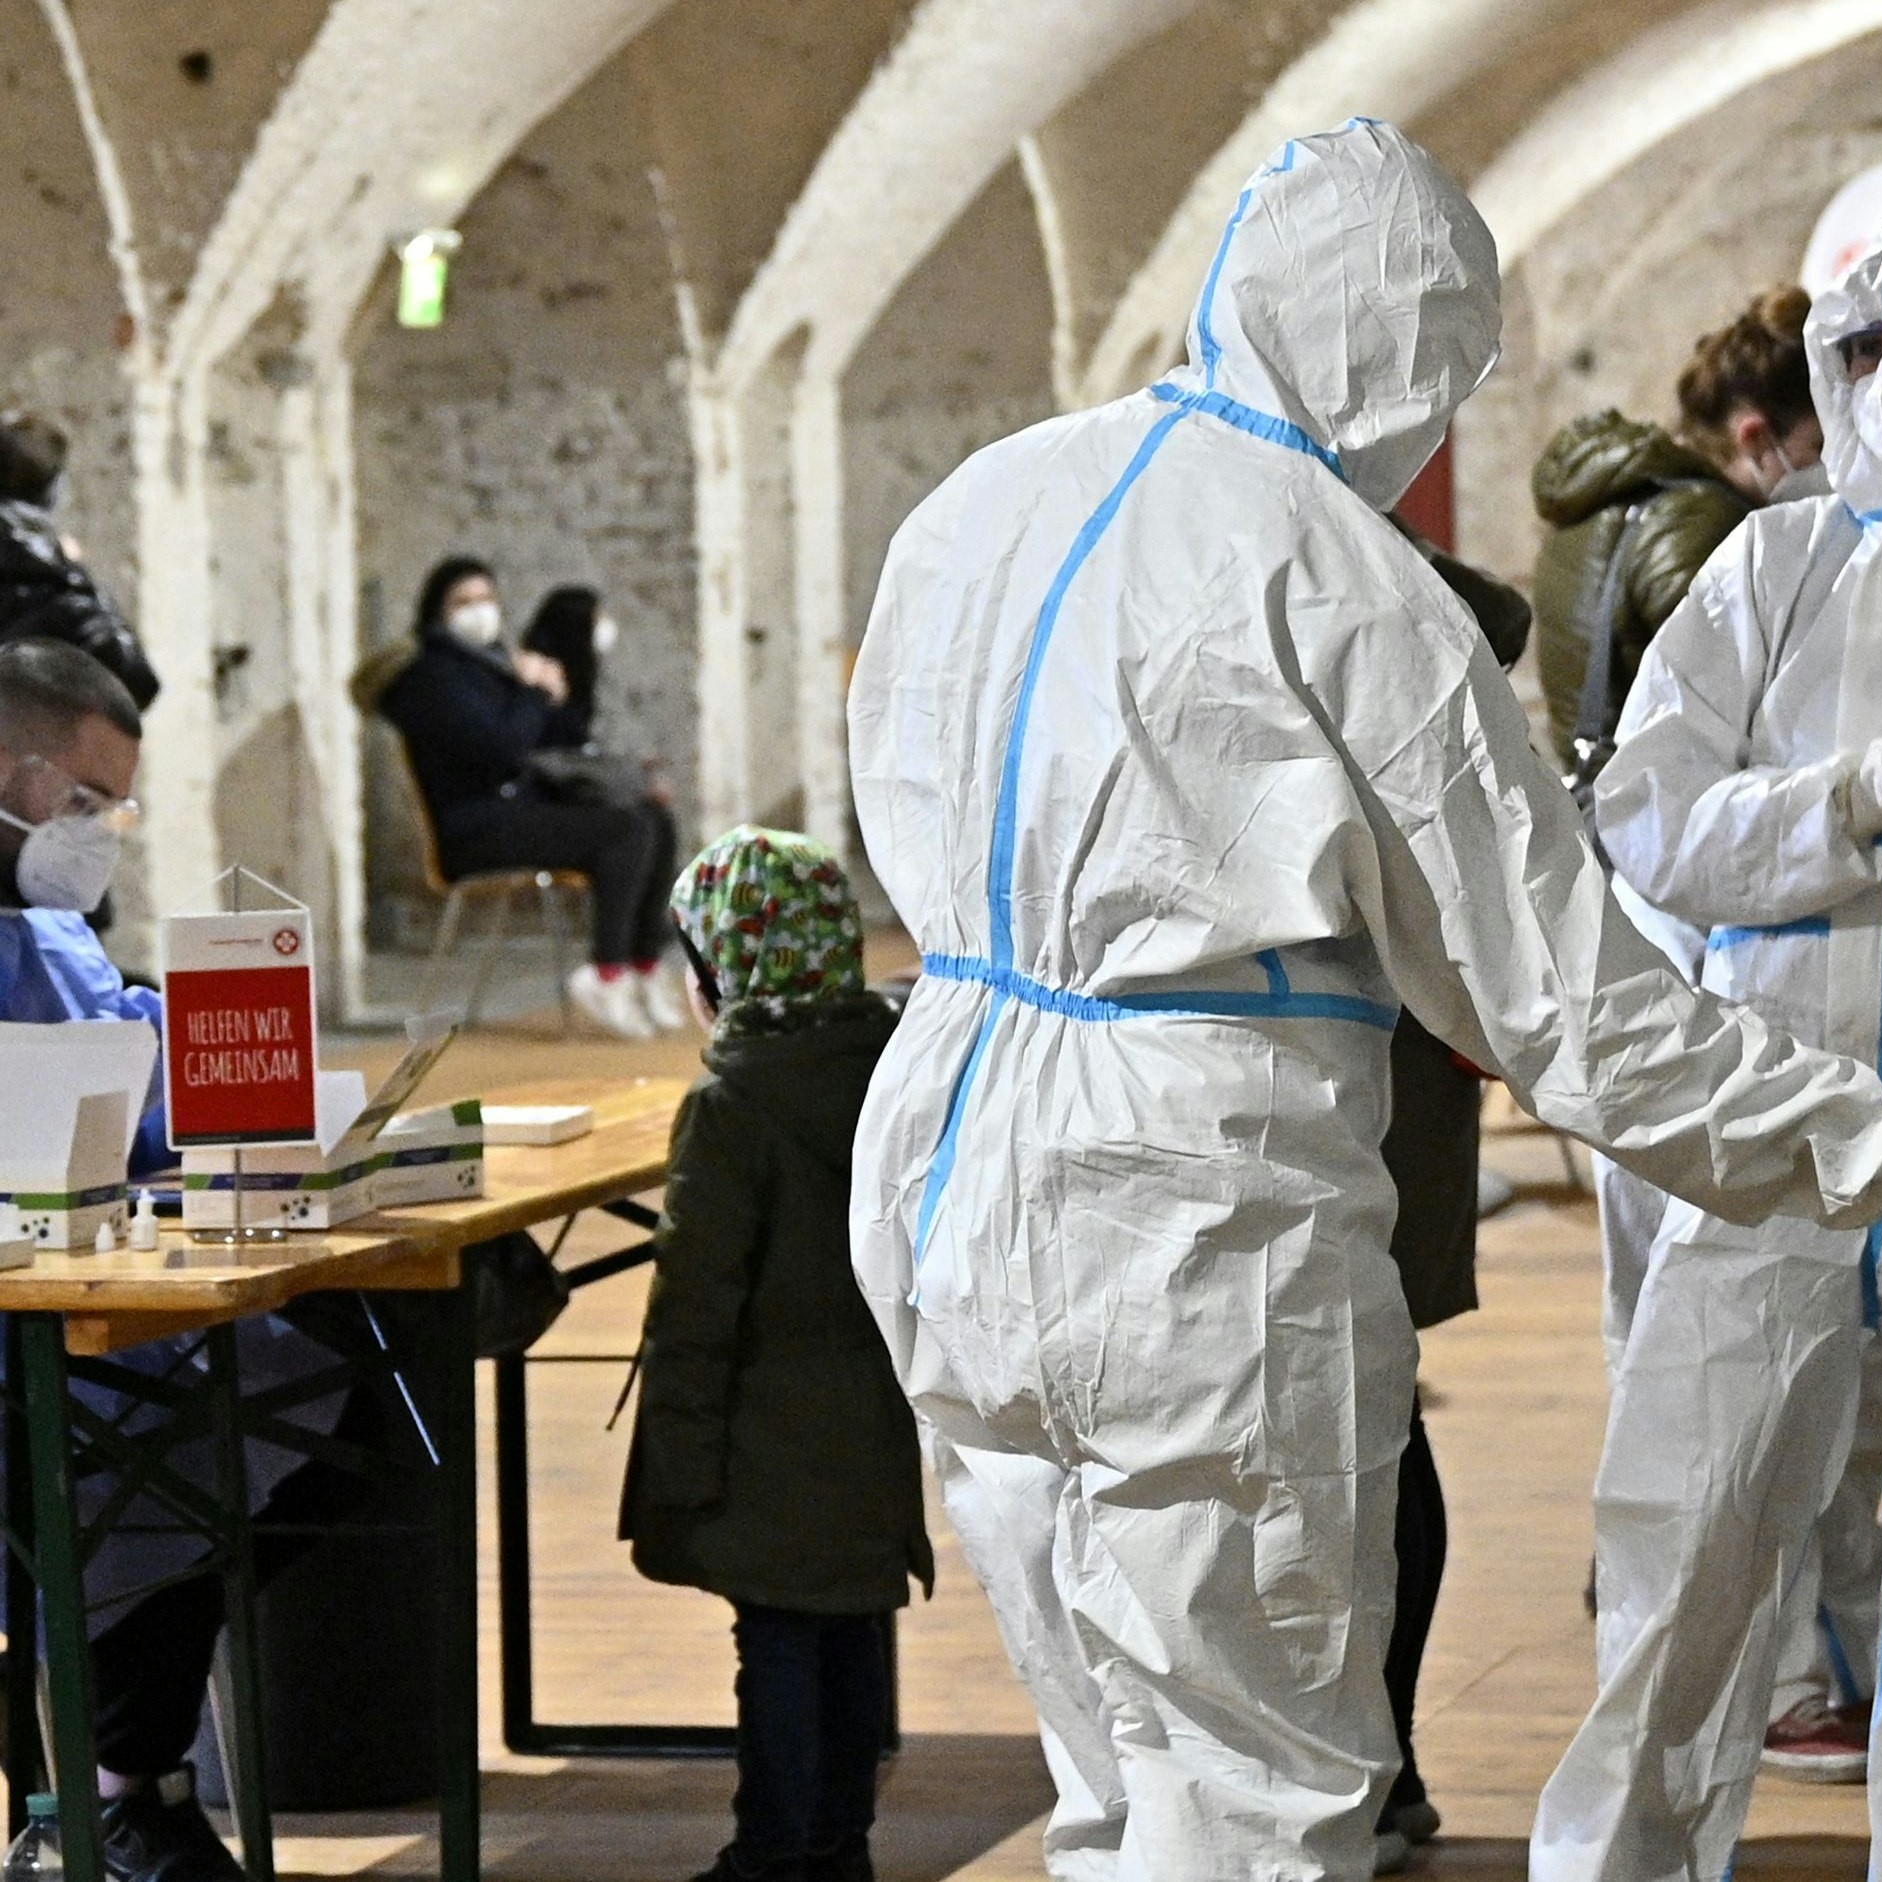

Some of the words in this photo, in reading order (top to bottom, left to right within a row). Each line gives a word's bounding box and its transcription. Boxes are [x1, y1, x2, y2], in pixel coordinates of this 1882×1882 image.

[187, 1008, 250, 1045] HELFEN
[254, 1006, 293, 1042] WIR
[184, 1048, 299, 1087] GEMEINSAM
